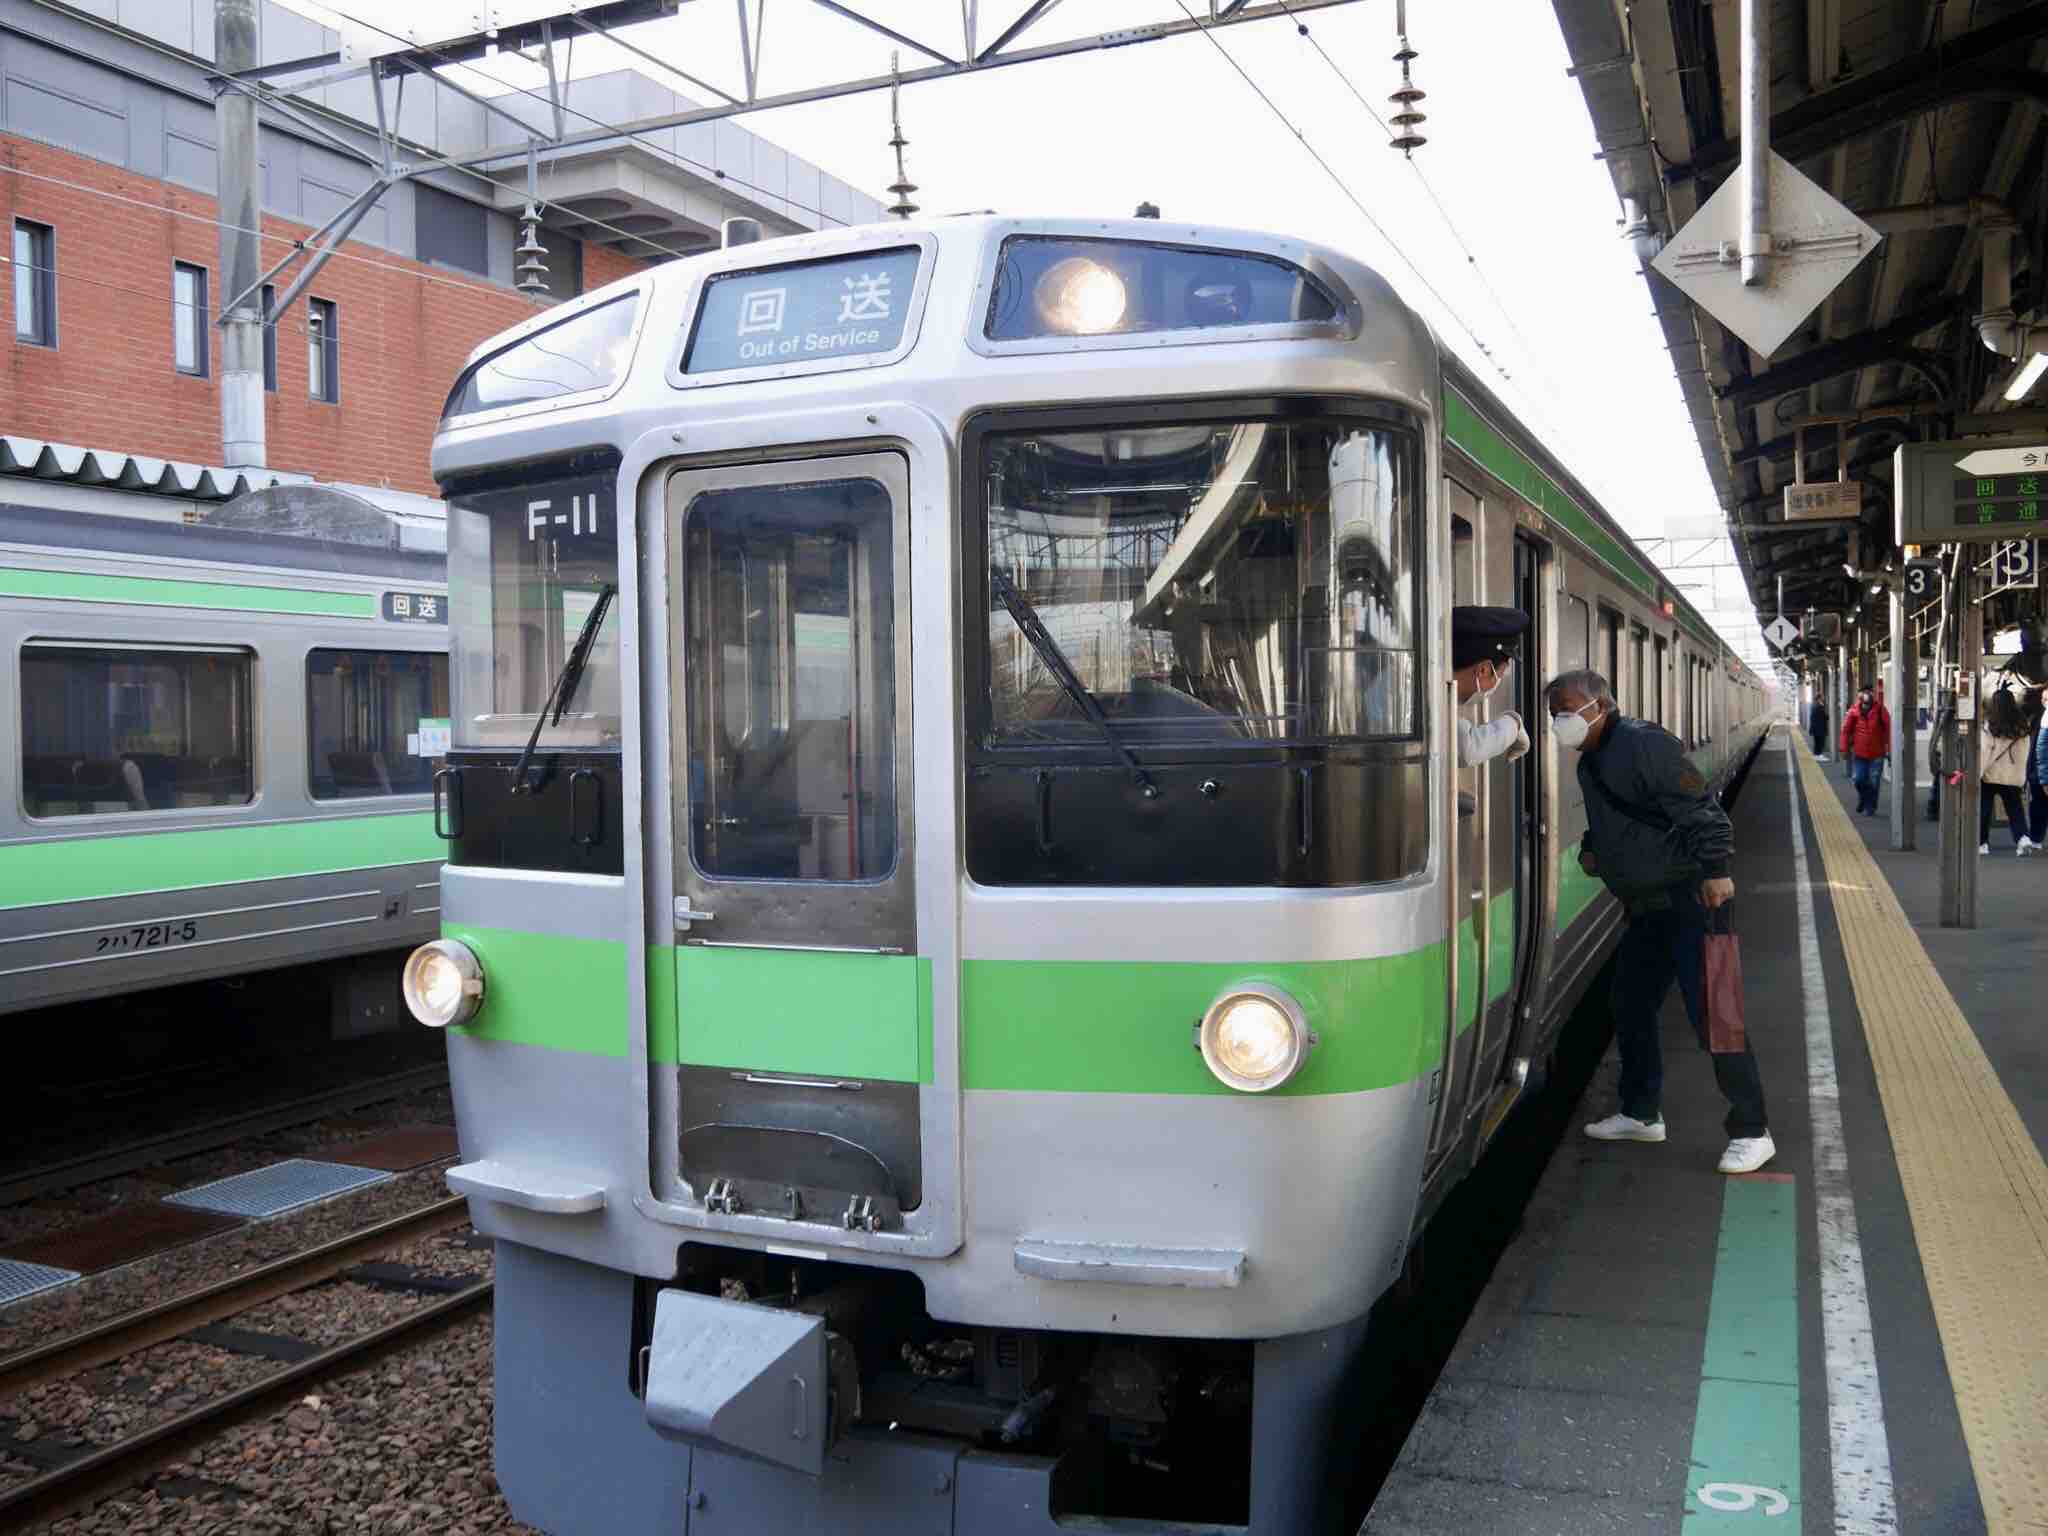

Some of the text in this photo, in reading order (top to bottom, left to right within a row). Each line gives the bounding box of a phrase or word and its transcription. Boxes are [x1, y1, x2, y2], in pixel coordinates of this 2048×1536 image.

[737, 271, 891, 337] 回送
[739, 327, 880, 360] Out of Service
[2022, 451, 2048, 467] 今
[528, 493, 597, 541] F-11
[2001, 540, 2029, 576] 3
[1909, 569, 1925, 594] 3
[392, 595, 437, 618] 回送
[1777, 625, 1783, 640] 1
